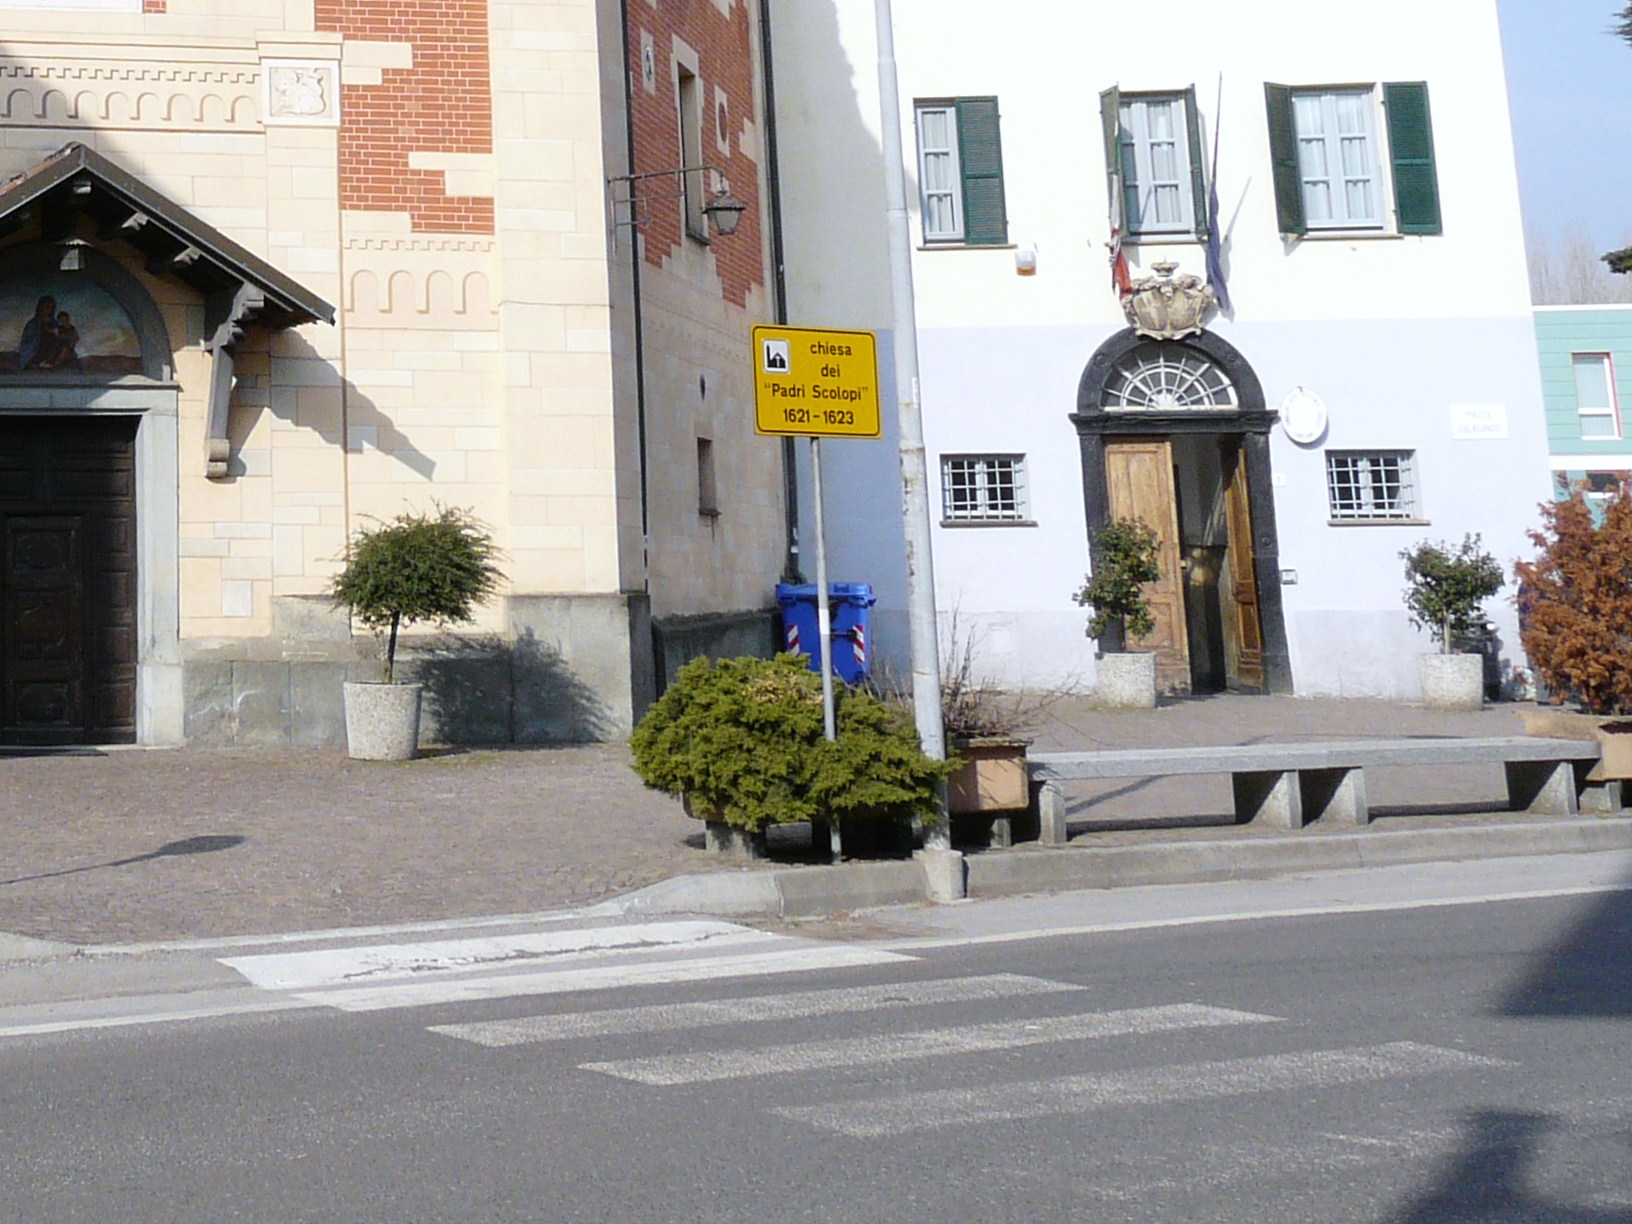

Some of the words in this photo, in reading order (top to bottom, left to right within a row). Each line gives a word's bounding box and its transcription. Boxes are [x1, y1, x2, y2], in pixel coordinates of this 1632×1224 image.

[810, 341, 852, 356] chiesa
[821, 364, 841, 378] dei
[783, 408, 811, 423] 1621
[823, 410, 855, 425] 1623
